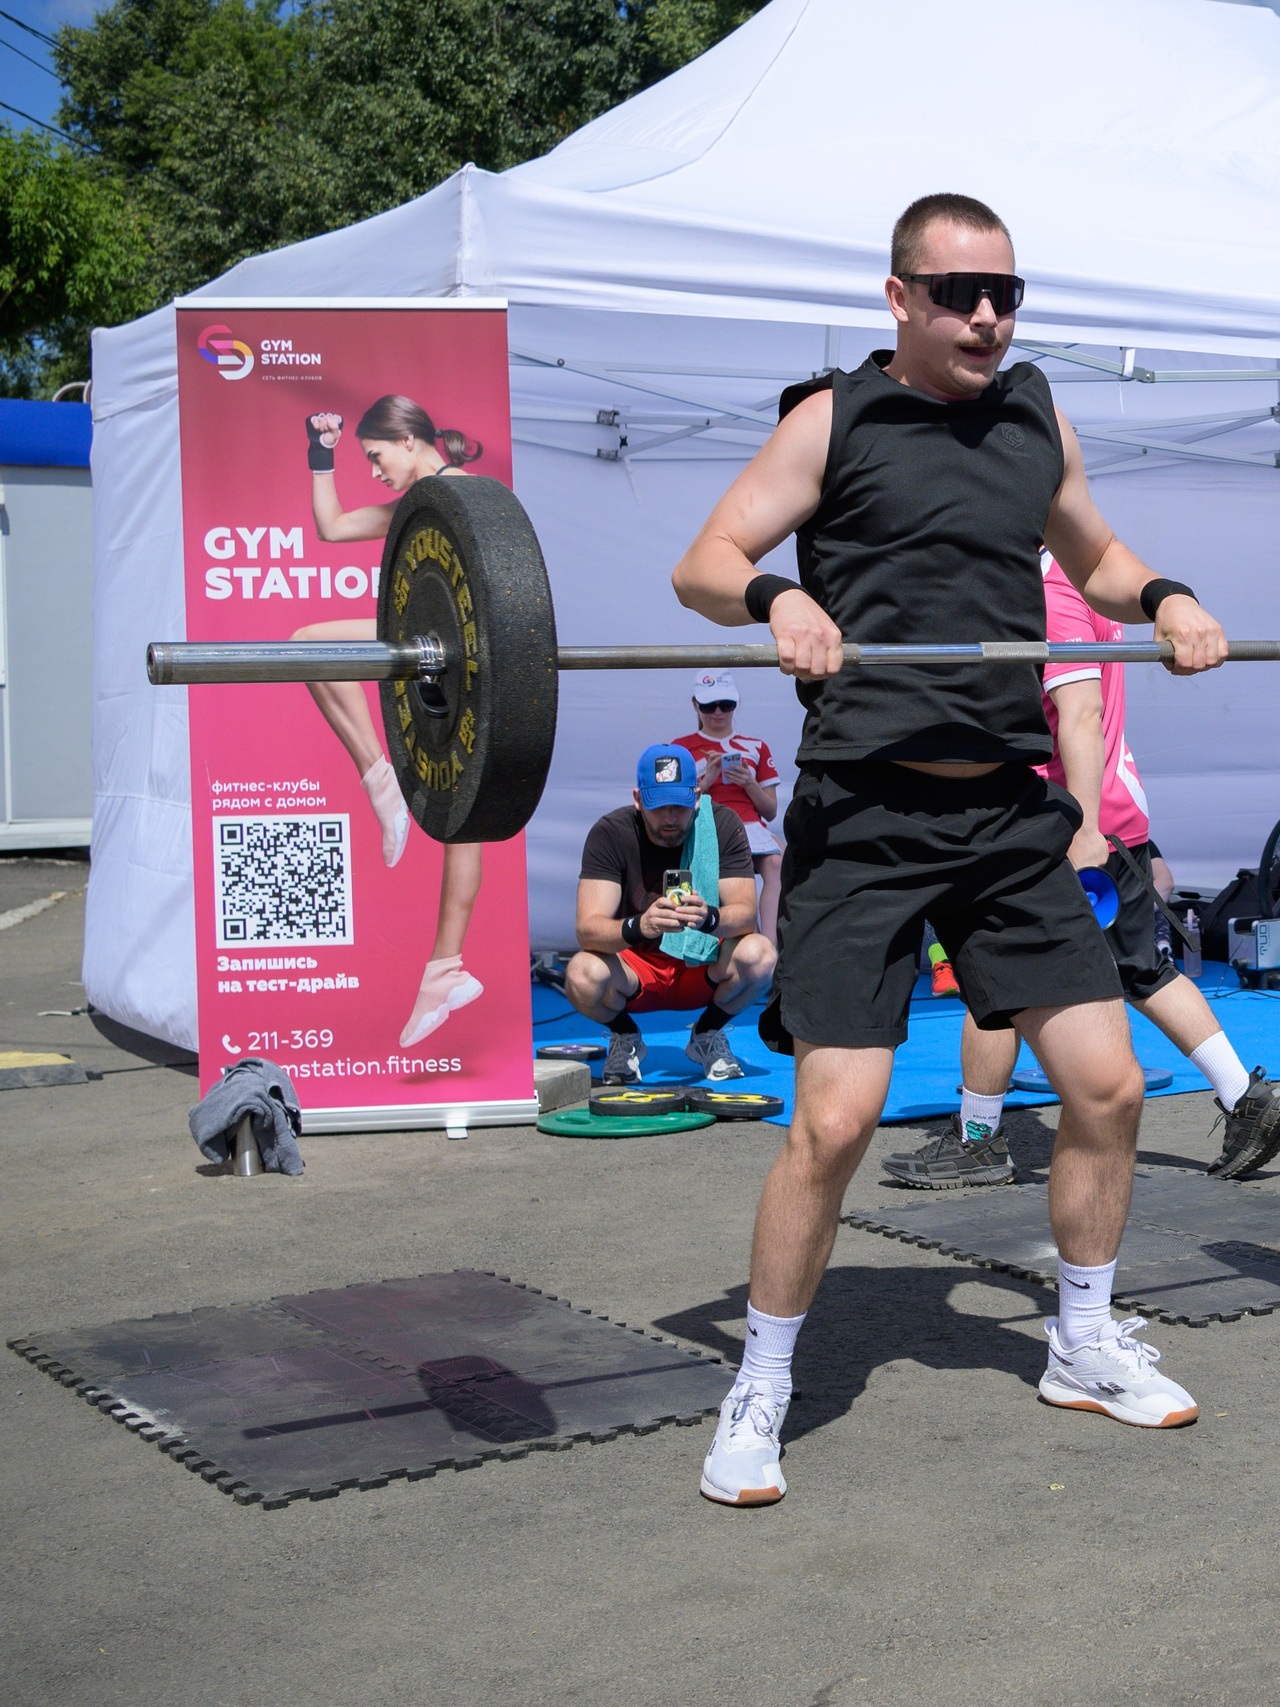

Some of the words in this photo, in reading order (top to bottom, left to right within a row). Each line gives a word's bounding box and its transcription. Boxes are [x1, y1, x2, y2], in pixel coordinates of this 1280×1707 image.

[260, 340, 293, 352] GYM
[260, 353, 322, 365] STATION
[204, 527, 304, 559] GYM
[212, 778, 321, 796] фитнес-клубы
[212, 797, 261, 811] рядом
[264, 797, 273, 808] с
[276, 795, 327, 809] домом
[217, 955, 318, 972] Запишись
[218, 979, 242, 993] на
[246, 974, 360, 994] тест-драйв
[247, 1029, 334, 1051] 211-369
